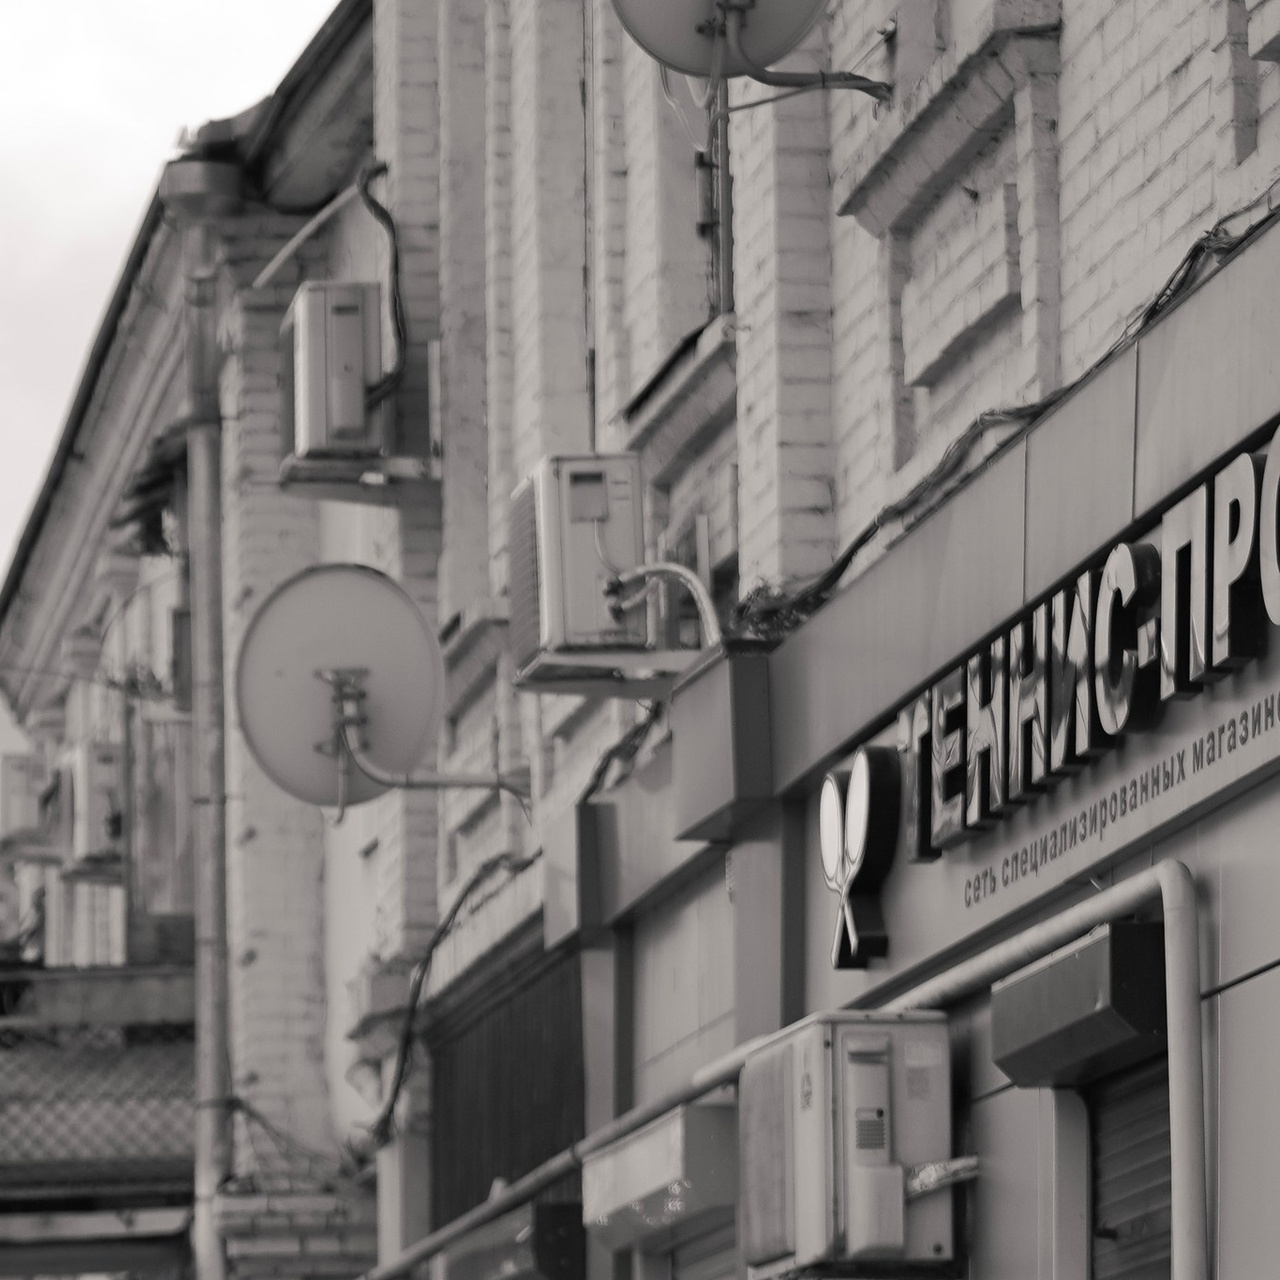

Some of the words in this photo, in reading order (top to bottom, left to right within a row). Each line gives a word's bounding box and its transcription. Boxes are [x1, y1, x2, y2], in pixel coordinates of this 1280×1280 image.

[964, 860, 997, 908] сеть
[1001, 748, 1186, 885] специализированных
[1192, 689, 1280, 774] магазин
